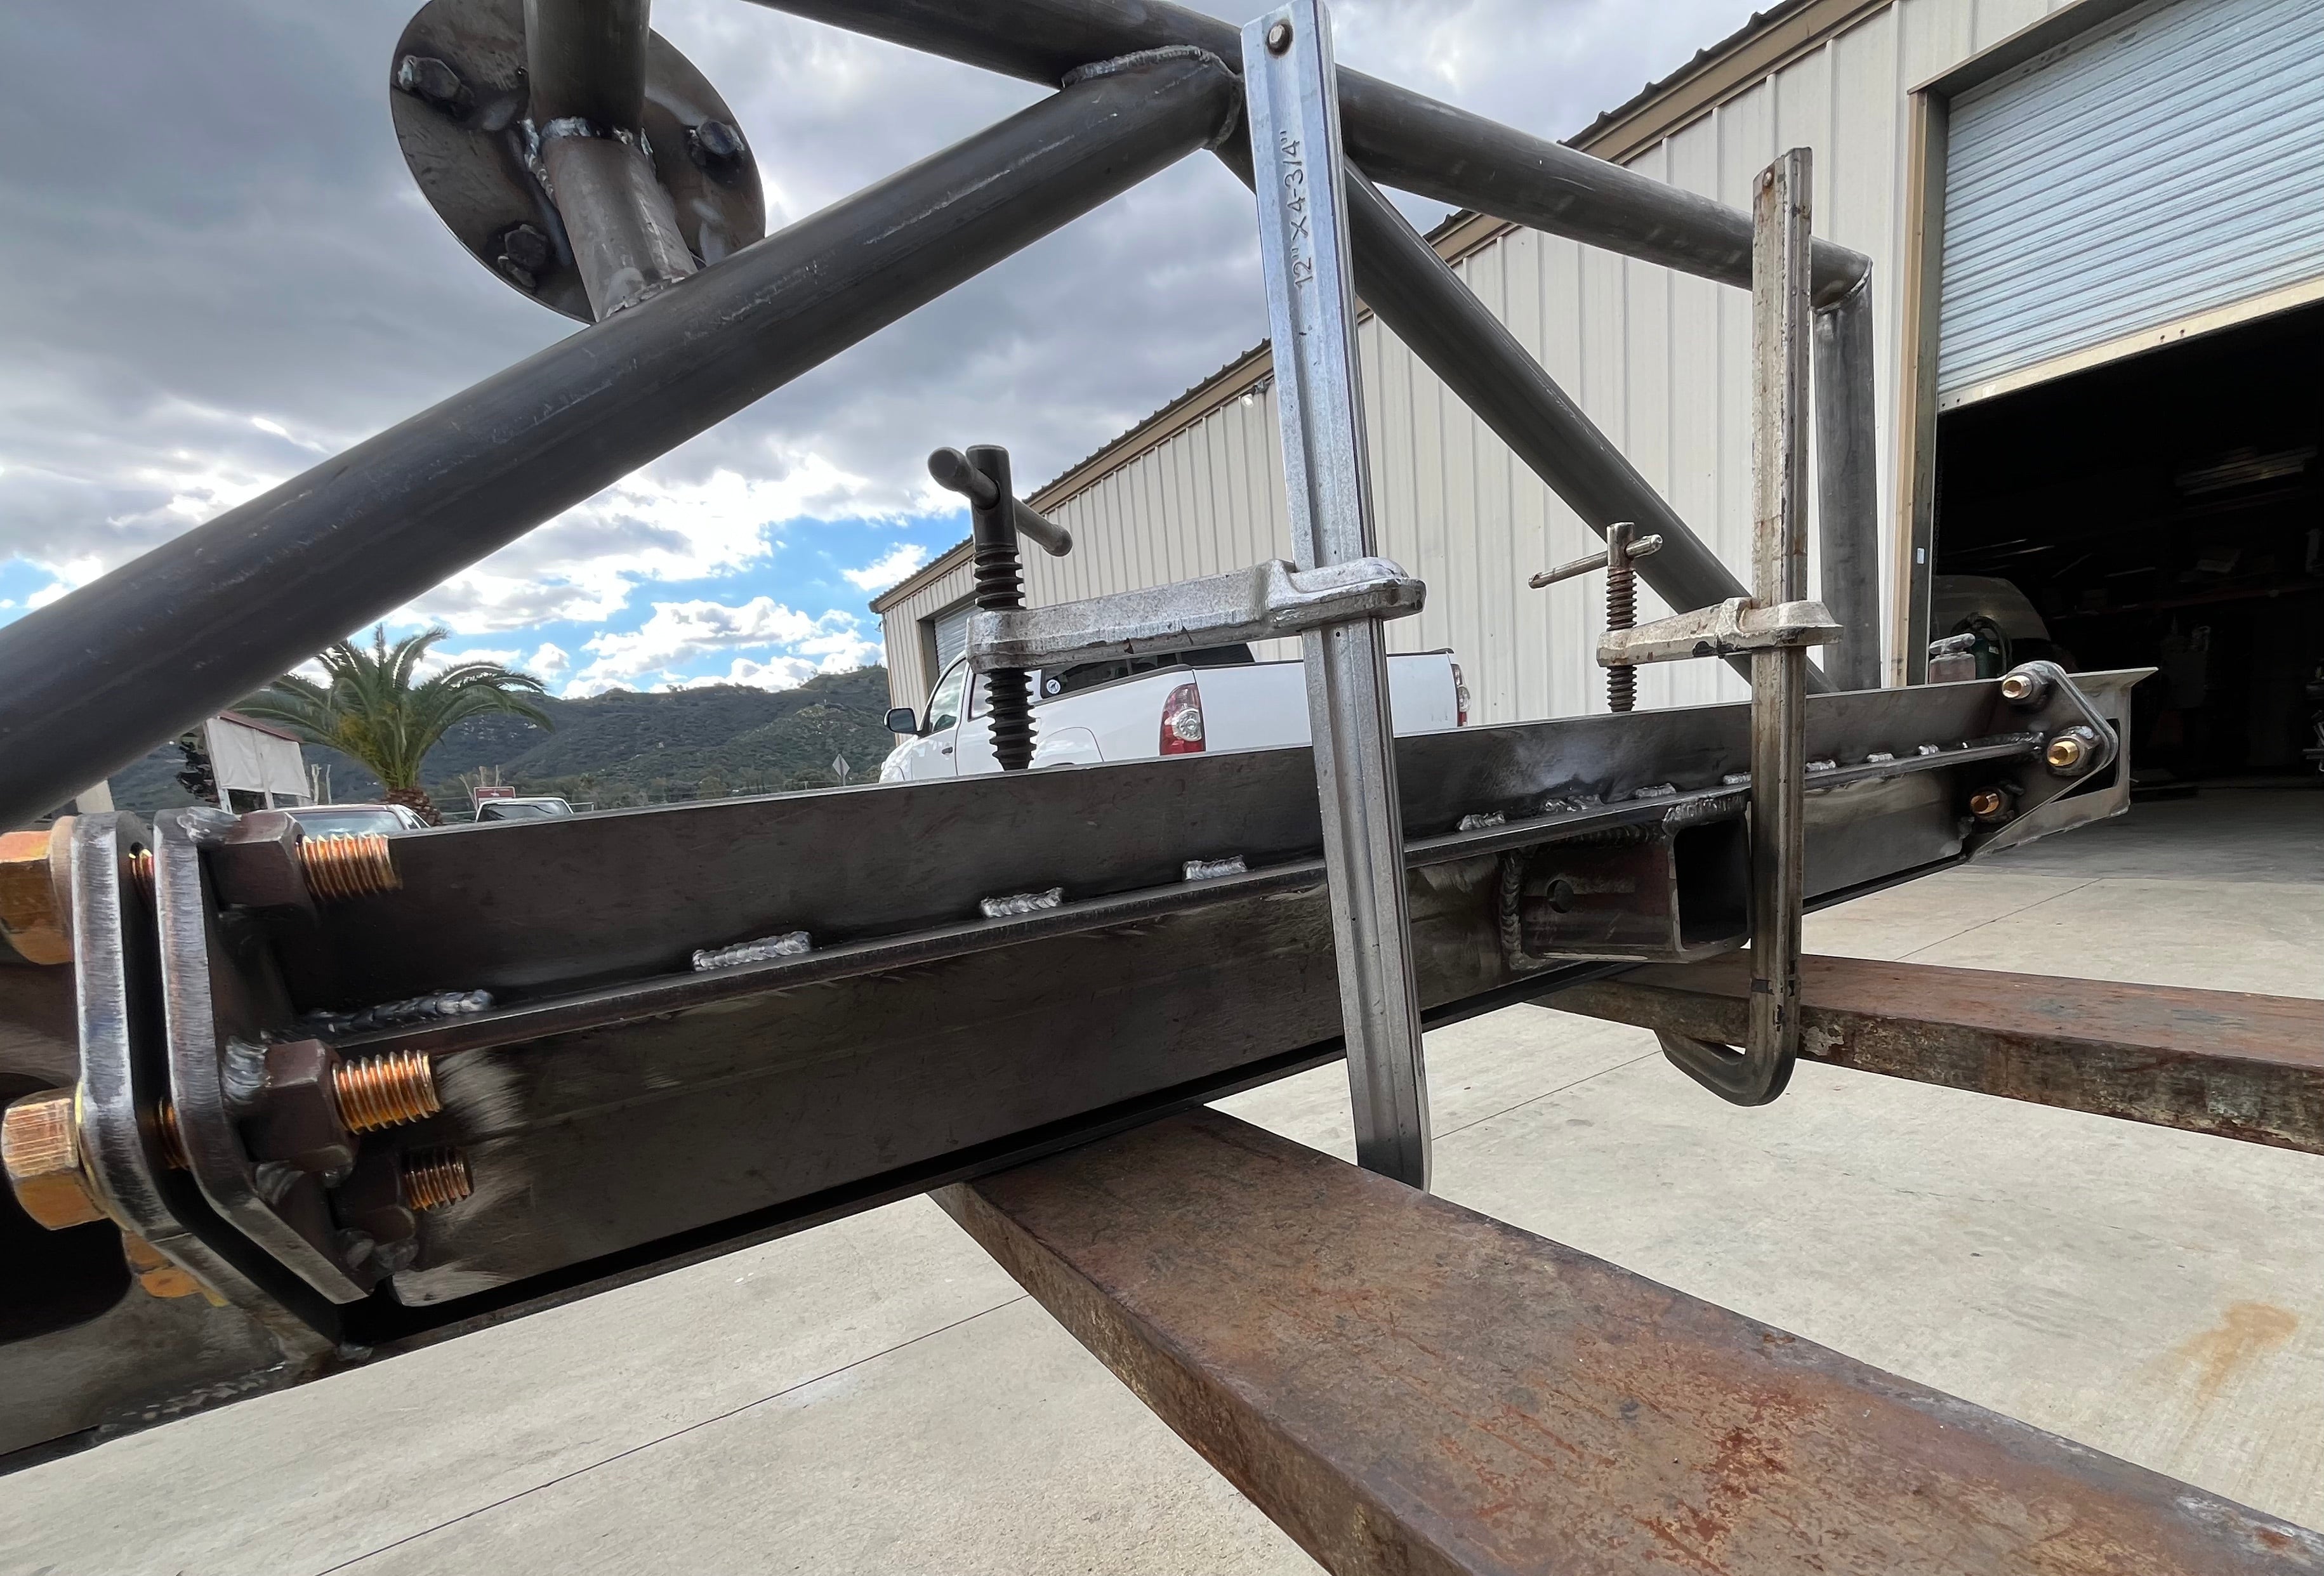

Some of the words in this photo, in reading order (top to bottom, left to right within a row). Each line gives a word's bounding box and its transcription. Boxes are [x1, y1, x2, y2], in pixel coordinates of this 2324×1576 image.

[1280, 131, 1305, 211] 4-3/4"
[1291, 216, 1308, 240] X
[1291, 248, 1314, 289] 12"
